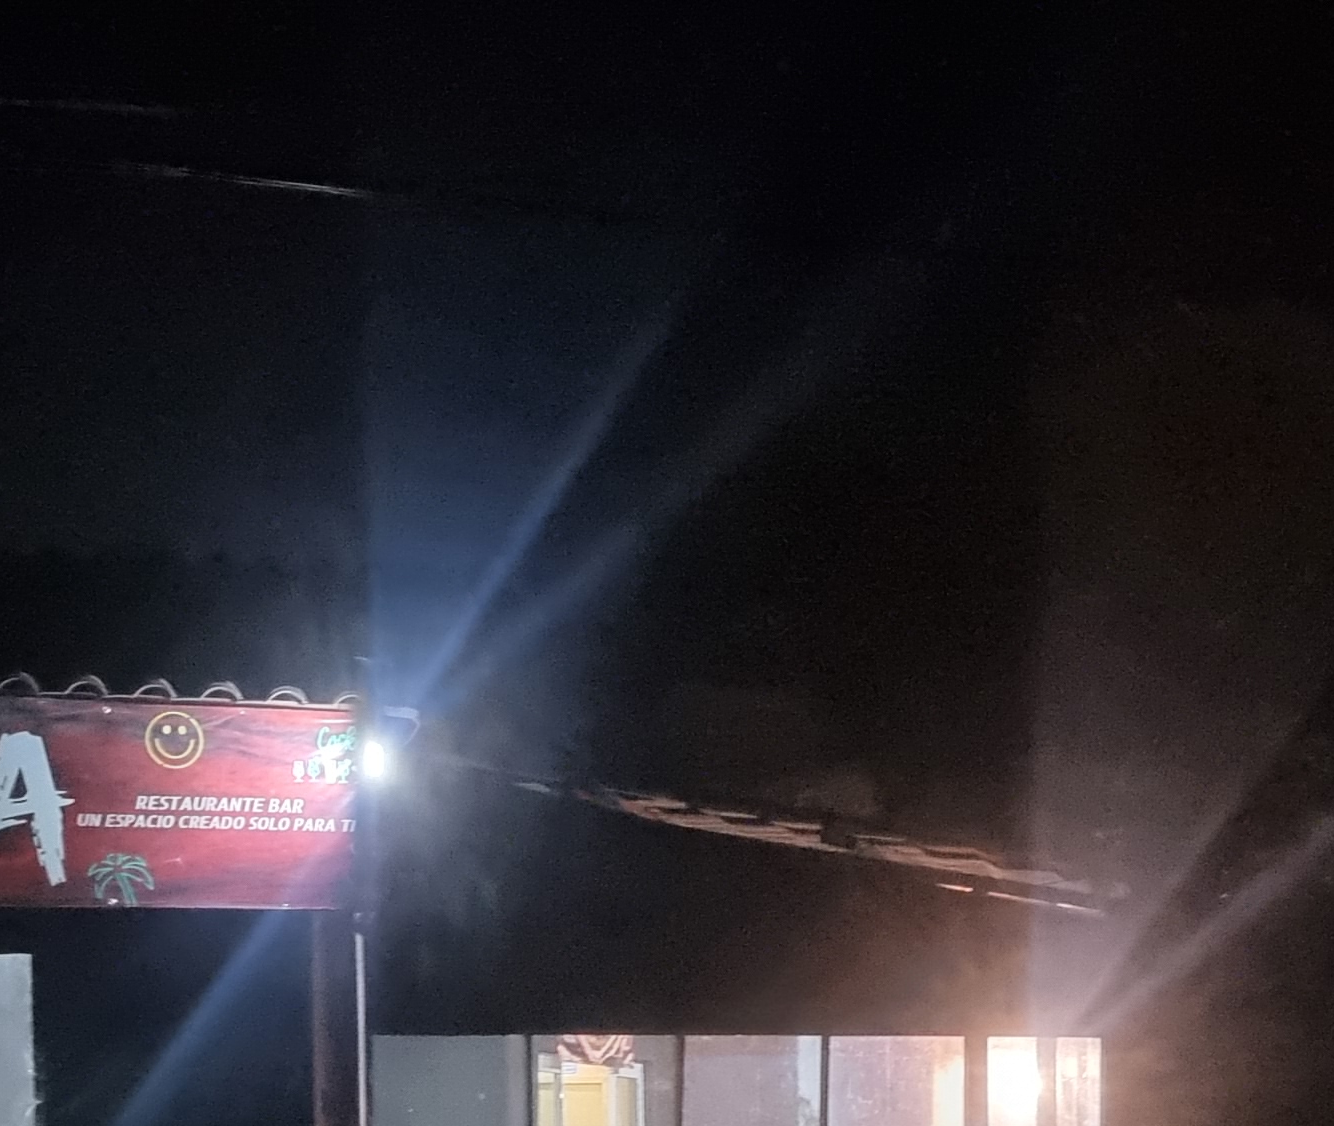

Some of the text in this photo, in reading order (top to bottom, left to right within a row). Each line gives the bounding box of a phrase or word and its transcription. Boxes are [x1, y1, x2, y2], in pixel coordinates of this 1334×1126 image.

[135, 795, 305, 814] RESTAURANTE BAR
[76, 813, 357, 833] UN ESPACIO CREADO SOLO PARA TI
